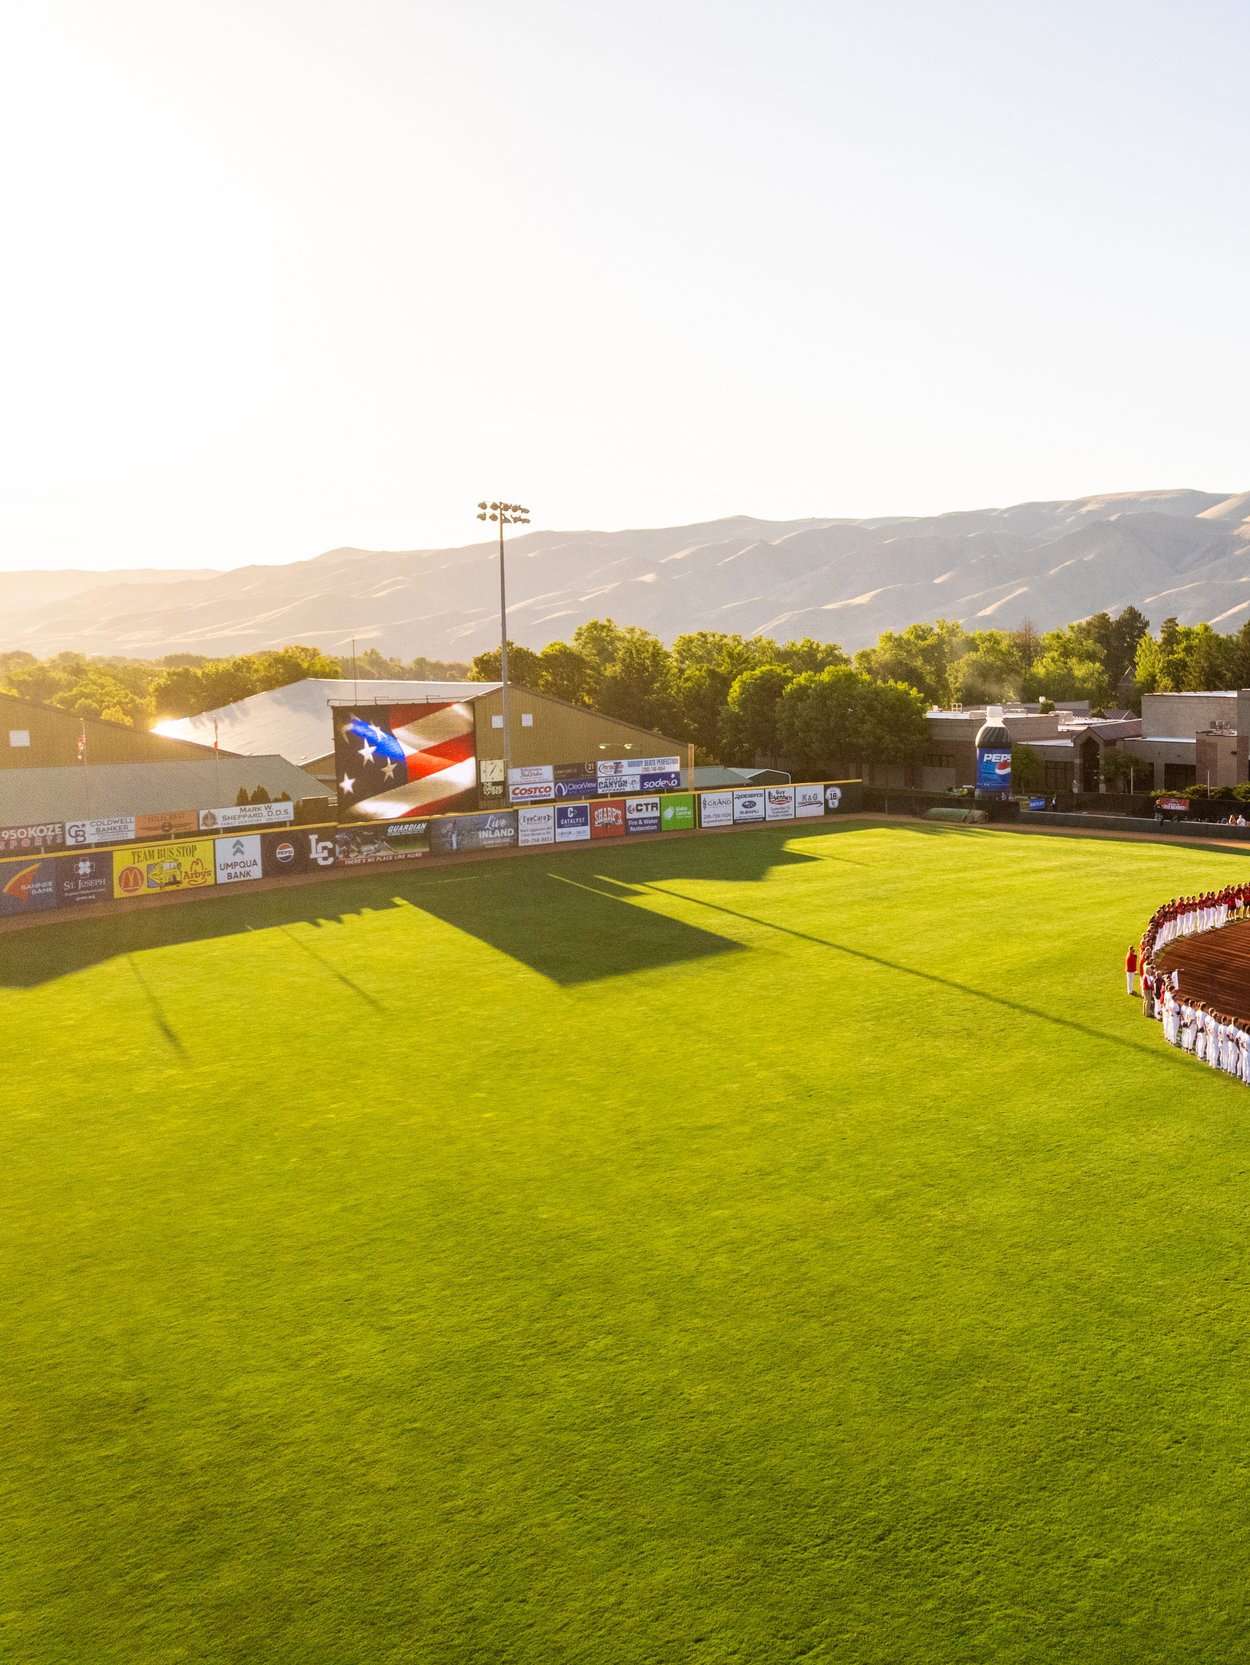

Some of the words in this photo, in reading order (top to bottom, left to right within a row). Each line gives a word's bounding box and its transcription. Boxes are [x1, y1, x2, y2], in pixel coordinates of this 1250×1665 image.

[598, 779, 628, 790] CANYON
[643, 776, 678, 789] sodexo
[512, 785, 552, 797] COSTCO
[90, 817, 135, 828] COLDWELL
[484, 815, 507, 831] Live
[560, 817, 586, 825] CATALYST
[2, 828, 28, 841] 950
[28, 823, 63, 838] KOZE
[95, 824, 129, 834] BANKER
[388, 823, 427, 834] GUARDIAN
[479, 828, 515, 839] INLAND
[132, 848, 156, 865] TEAM
[157, 846, 175, 862] BUS
[176, 844, 198, 858] STOP
[219, 859, 258, 872] UMPQUA
[183, 867, 211, 882] Arby's
[227, 870, 252, 882] BANK
